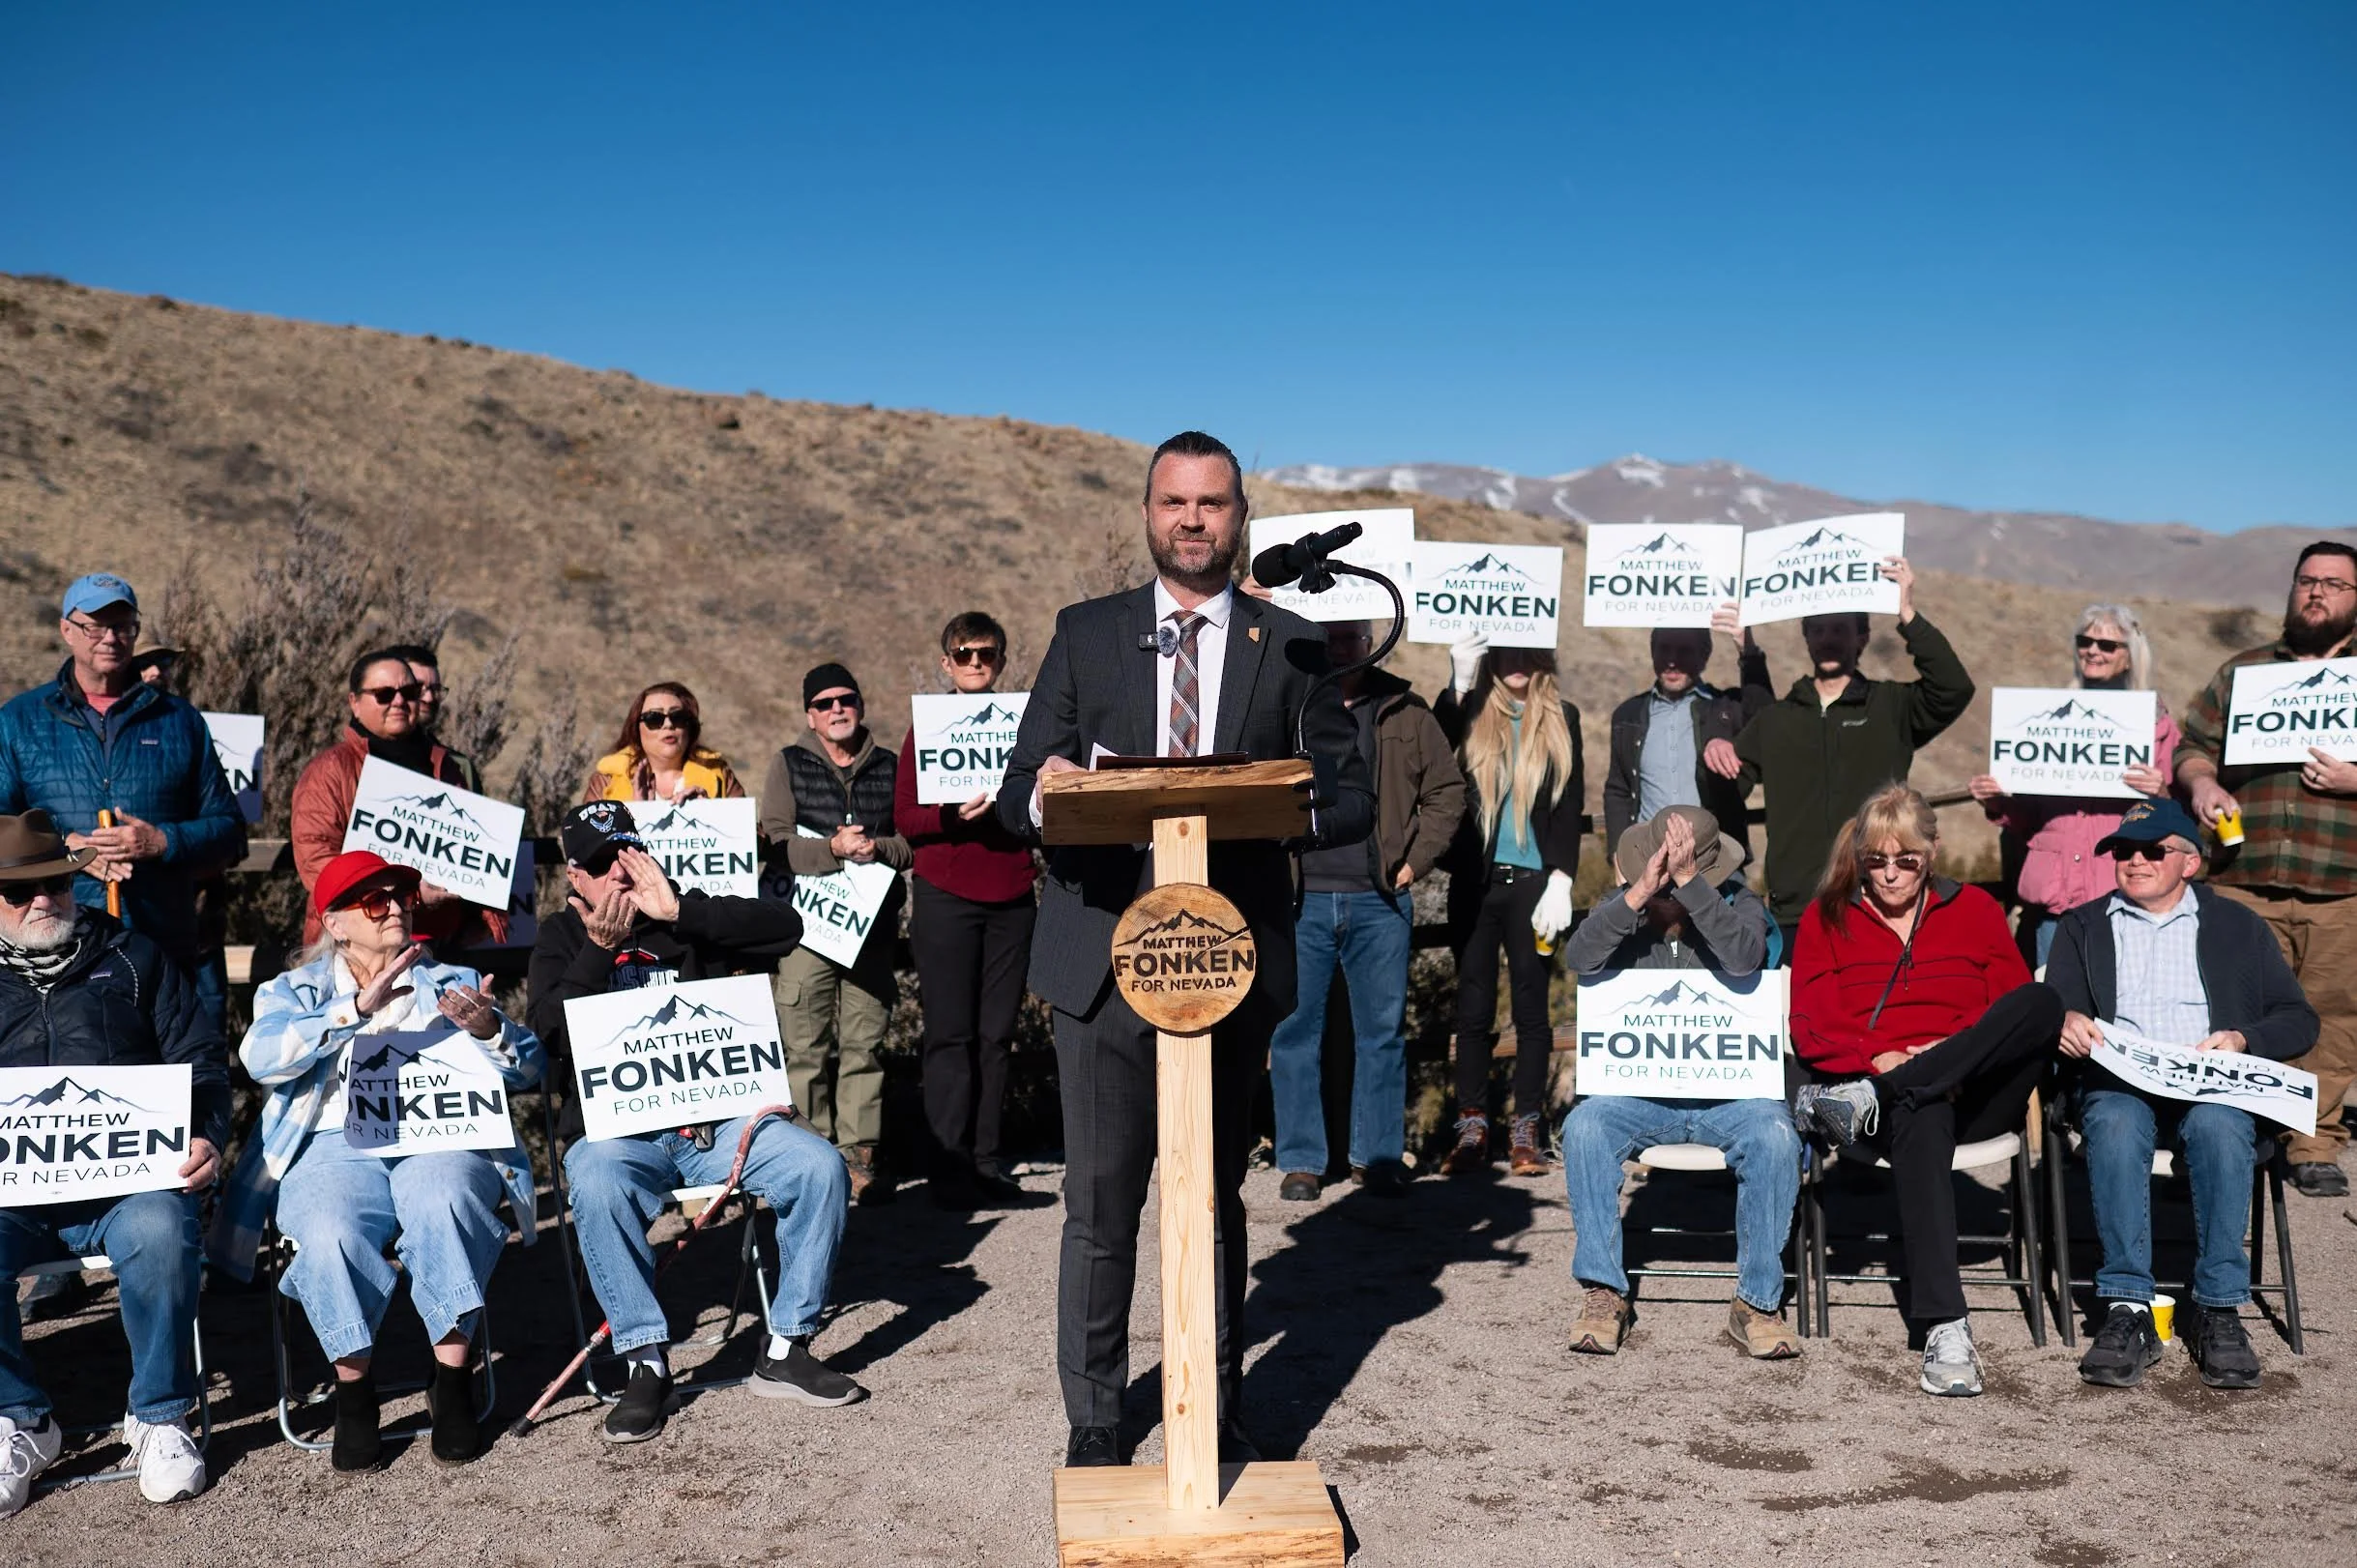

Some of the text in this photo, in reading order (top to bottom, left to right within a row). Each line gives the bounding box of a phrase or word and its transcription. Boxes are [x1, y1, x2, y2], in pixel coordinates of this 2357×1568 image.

[1620, 560, 1703, 570] MATTHEW
[1777, 549, 1862, 569] MATTHEW
[1444, 579, 1527, 593] MATTHEW
[1588, 574, 1736, 596] FONKEN
[1273, 595, 1309, 607] FOR
[1415, 592, 1557, 619] FONKEN
[1605, 601, 1714, 612] FOR NEVADA
[1760, 586, 1875, 612] FOR NEVADA
[1429, 619, 1536, 632] FOR NEVADA
[2232, 708, 2357, 734] FONK
[951, 731, 1017, 743] MATTHE
[2026, 726, 2114, 739] MATTHEW
[2252, 735, 2355, 748] FOR NEVA
[919, 747, 1014, 771] FONK
[1994, 740, 2149, 766] FONKEN
[939, 775, 973, 787] FOR
[2011, 767, 2044, 779] FOR
[393, 805, 480, 843] MATTHEW
[352, 808, 511, 879] FONKEN
[645, 837, 717, 851] ATTHEW
[367, 843, 486, 889] FOR NEVADA
[651, 852, 753, 877] NKEN
[1143, 935, 1222, 949] MATTHEW
[1114, 949, 1255, 977] FONKEN
[1131, 976, 1237, 992] FOR NEVADA
[1624, 1015, 1732, 1028] MATTHEW
[624, 1027, 733, 1055] MATTHEW
[1581, 1031, 1779, 1060] FONKEN
[581, 1041, 782, 1099] FONKEN
[1605, 1065, 1753, 1080] FOR NEVADA
[350, 1074, 450, 1092] ATTHEW
[348, 1090, 504, 1122] NKEN
[614, 1080, 762, 1116] FOR NEVADA
[374, 1123, 479, 1140] NEVADA
[0, 1126, 185, 1165] NKEN
[33, 1162, 151, 1184] NEVADA
